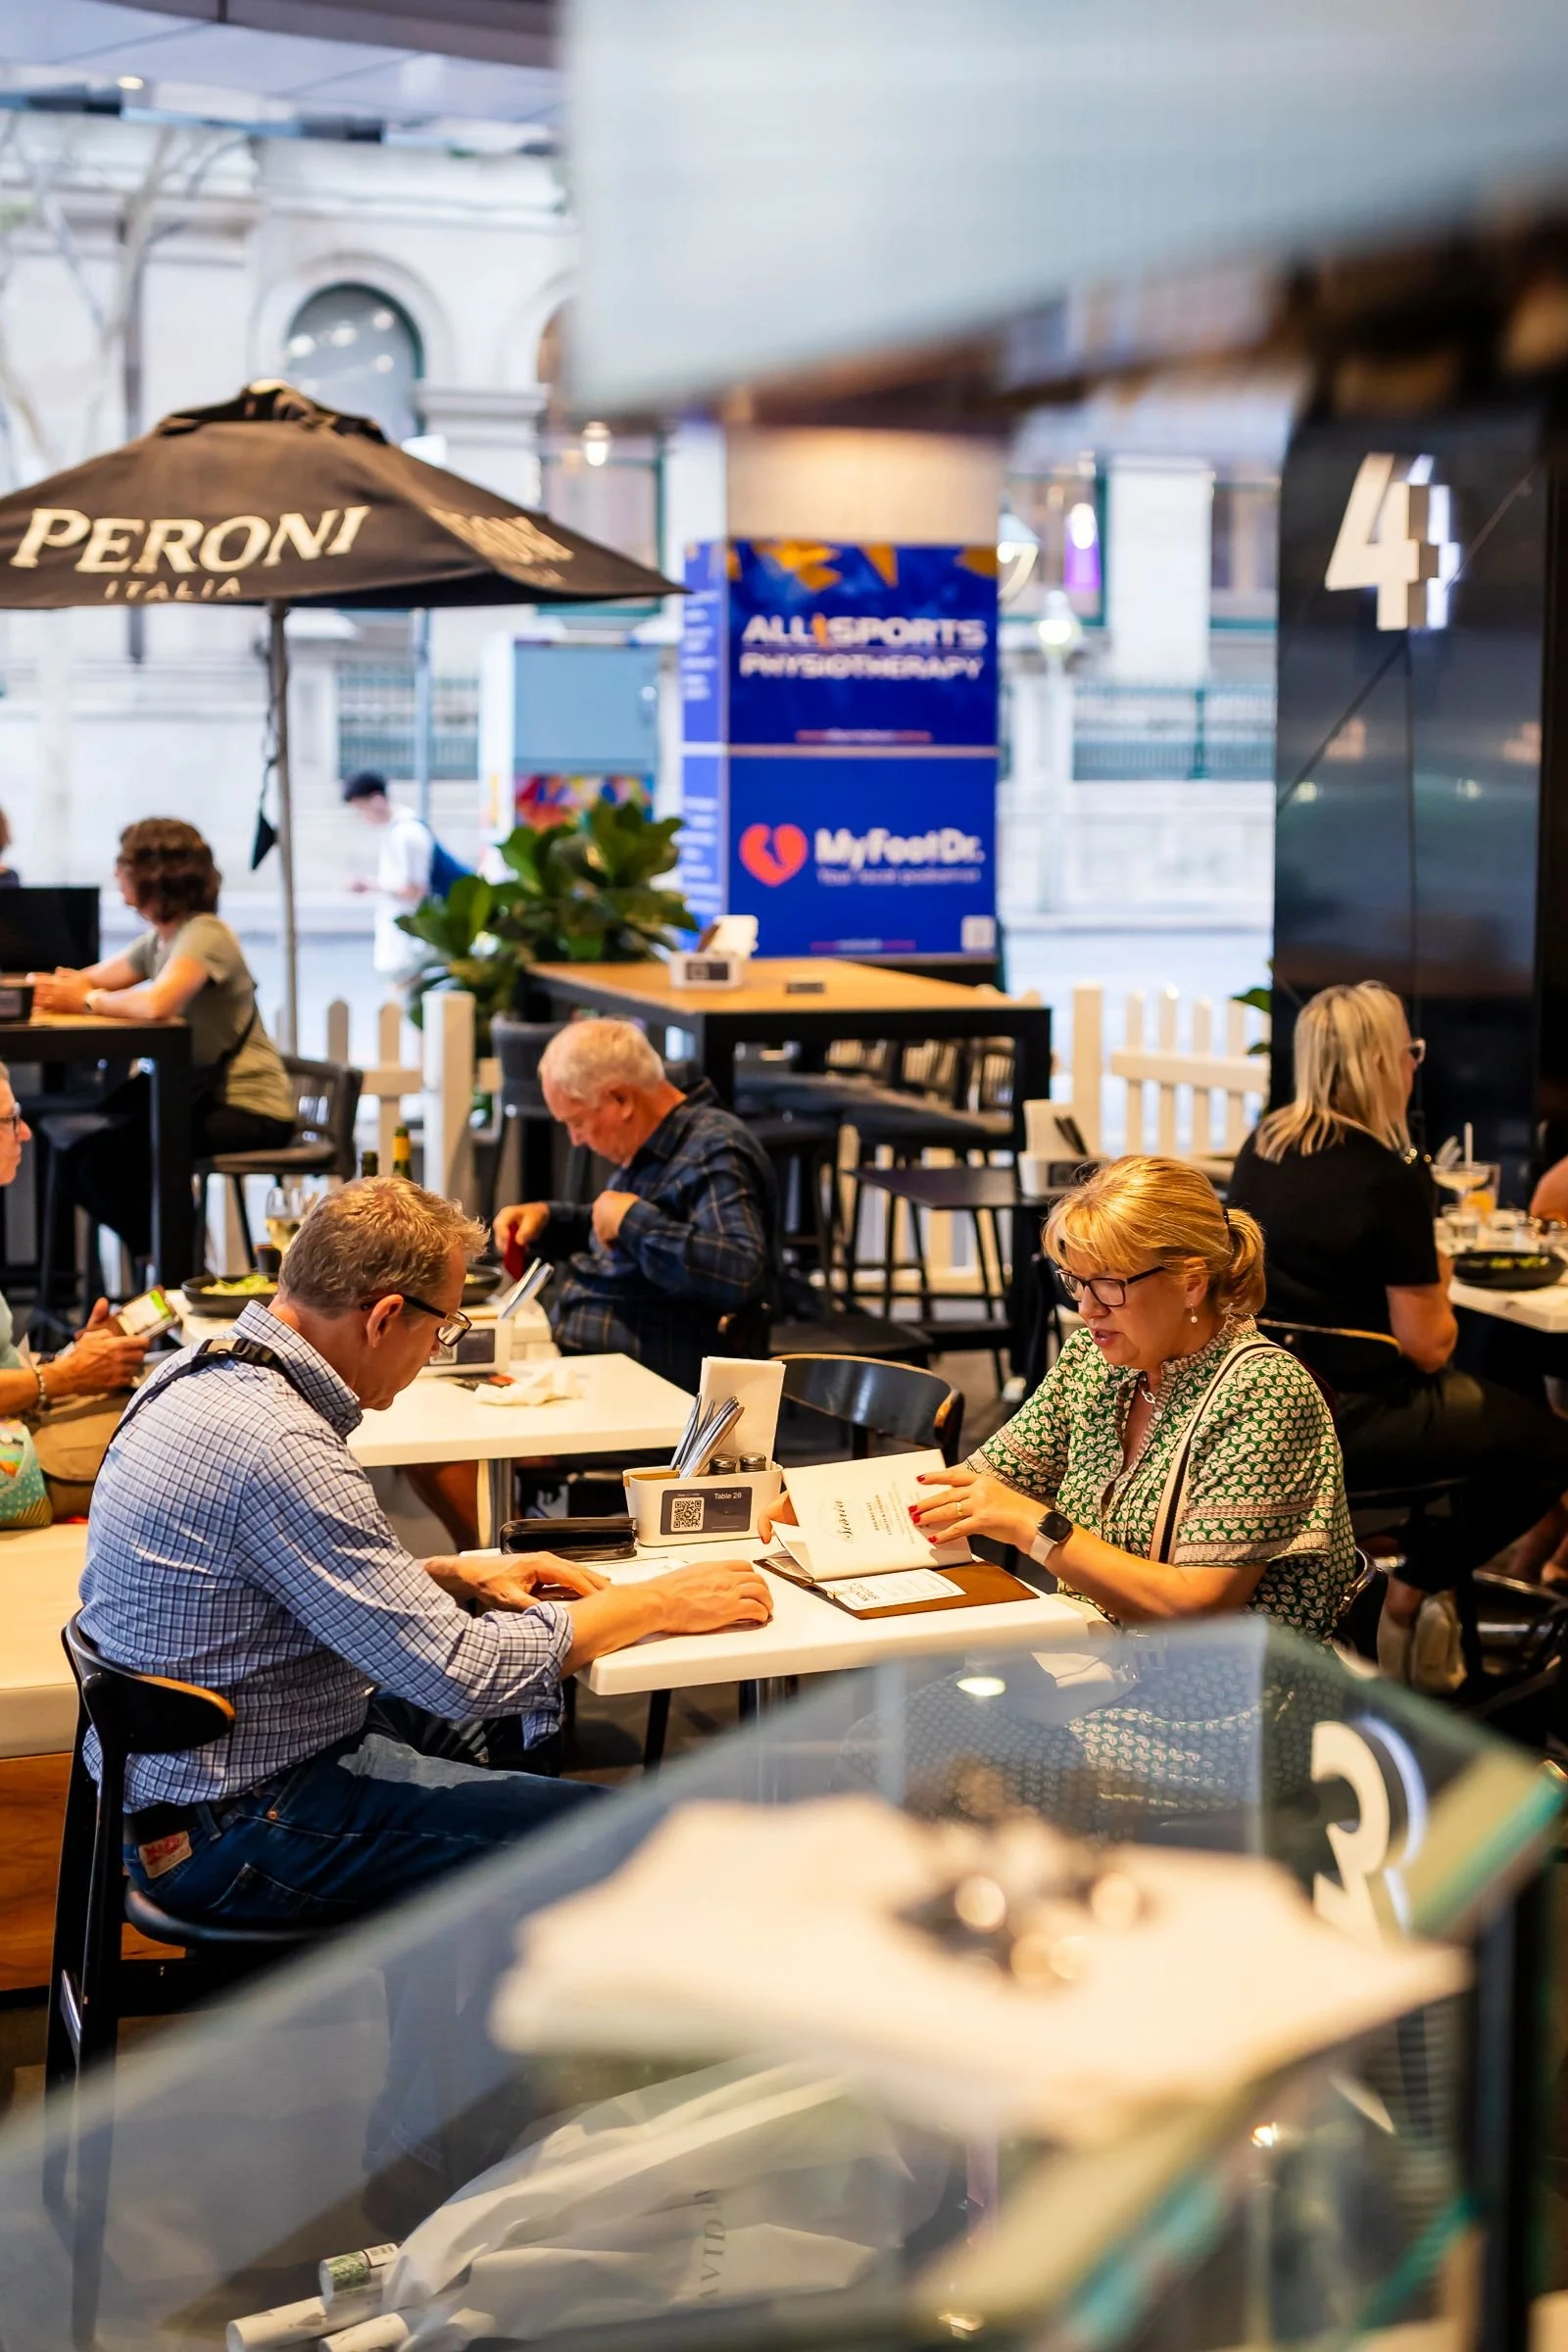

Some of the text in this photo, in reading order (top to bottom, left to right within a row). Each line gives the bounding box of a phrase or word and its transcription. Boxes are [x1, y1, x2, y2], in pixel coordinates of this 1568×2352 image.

[10, 505, 370, 574] PERONI
[1325, 452, 1426, 630] 4
[104, 578, 240, 600] ITALIA
[827, 616, 987, 648] SPORTS
